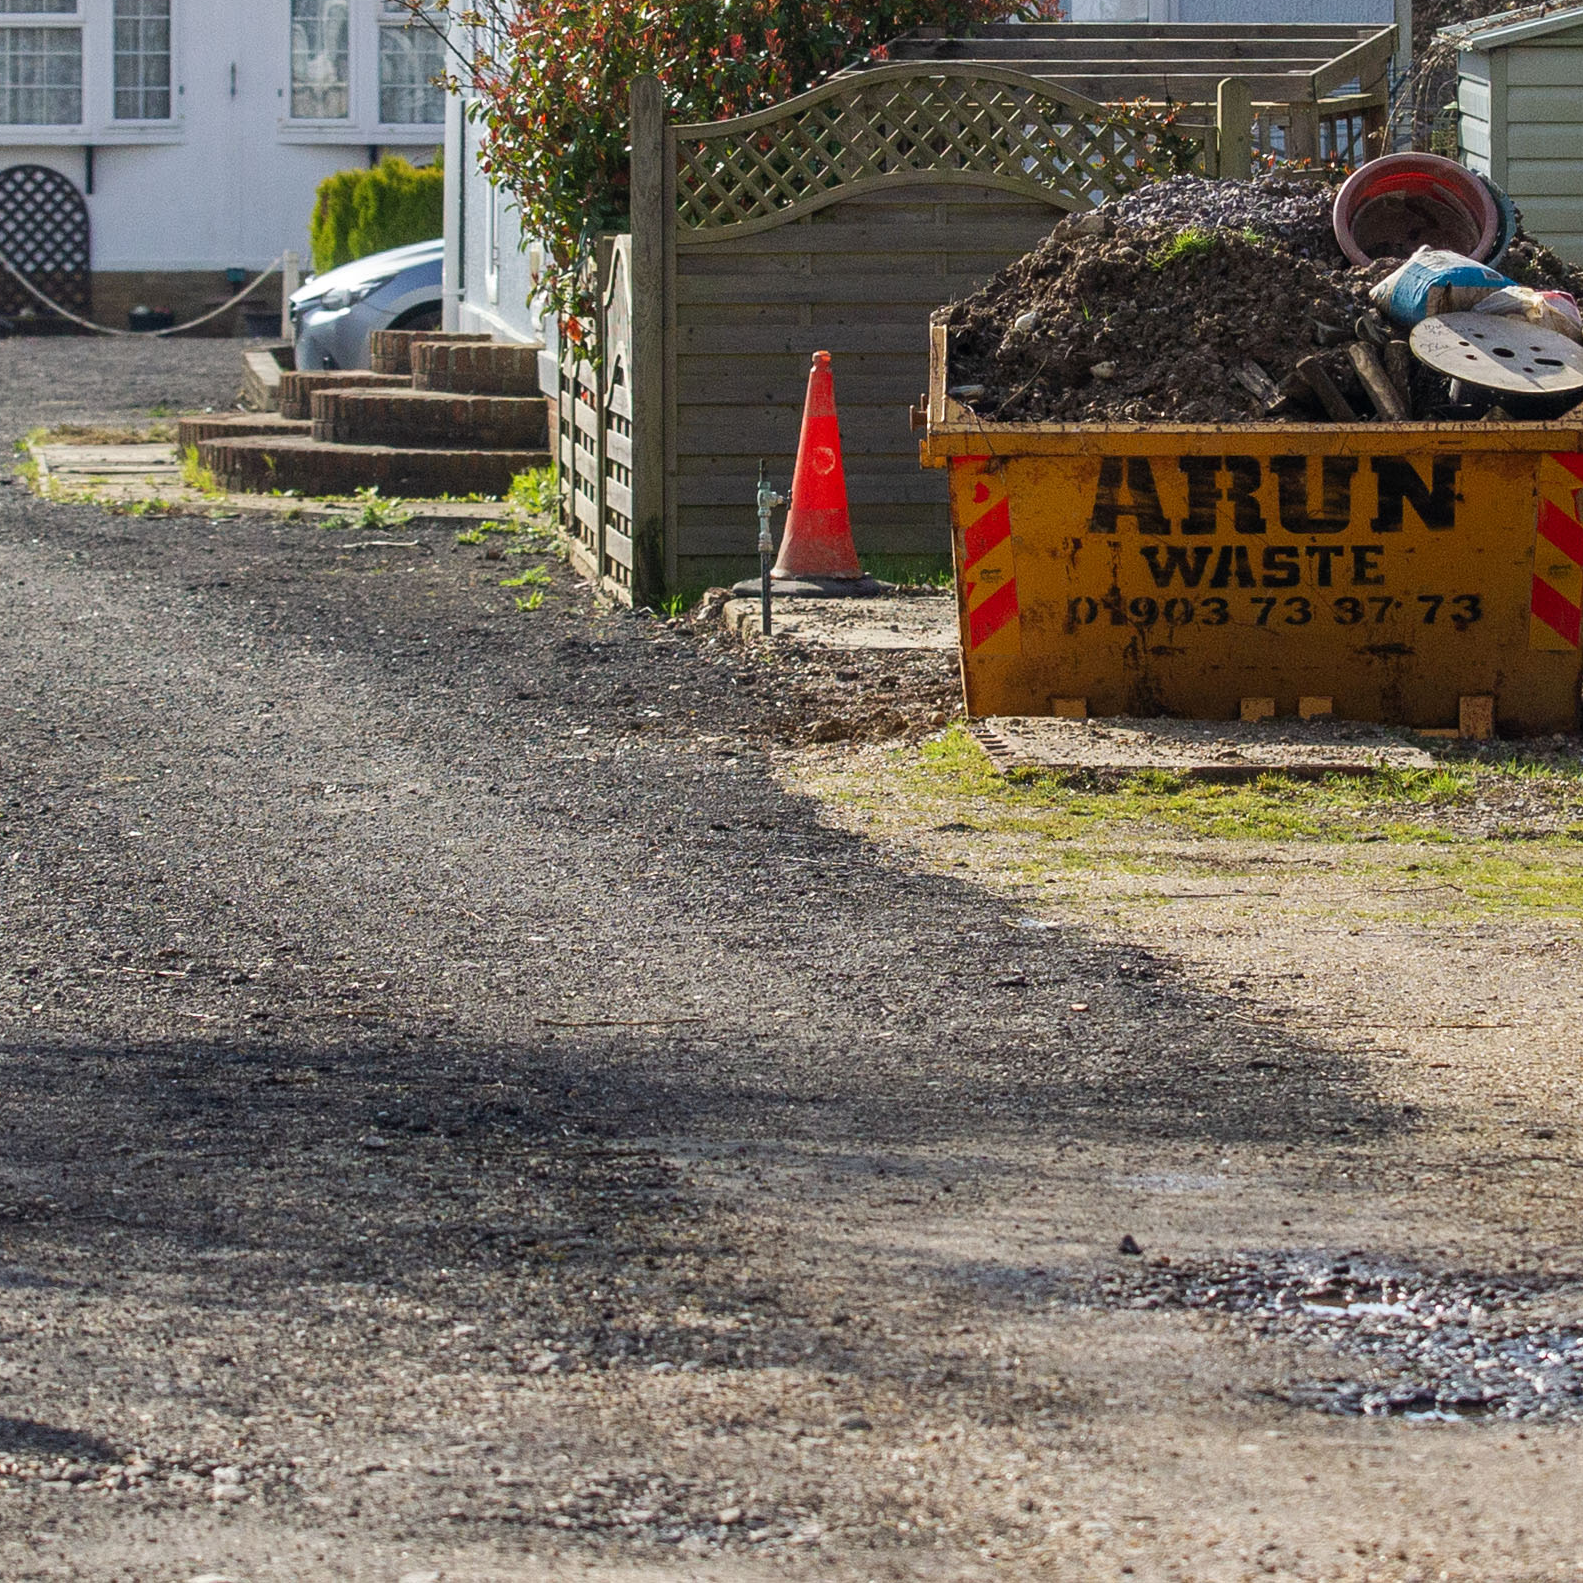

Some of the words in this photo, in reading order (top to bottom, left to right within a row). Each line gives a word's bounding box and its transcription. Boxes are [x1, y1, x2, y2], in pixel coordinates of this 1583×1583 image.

[1088, 454, 1461, 536] ARUN
[1140, 544, 1386, 589] WASTE
[1067, 595, 1231, 626] 01903
[1249, 595, 1313, 626] 73
[1333, 595, 1395, 624] 37
[1417, 594, 1484, 624] 73
